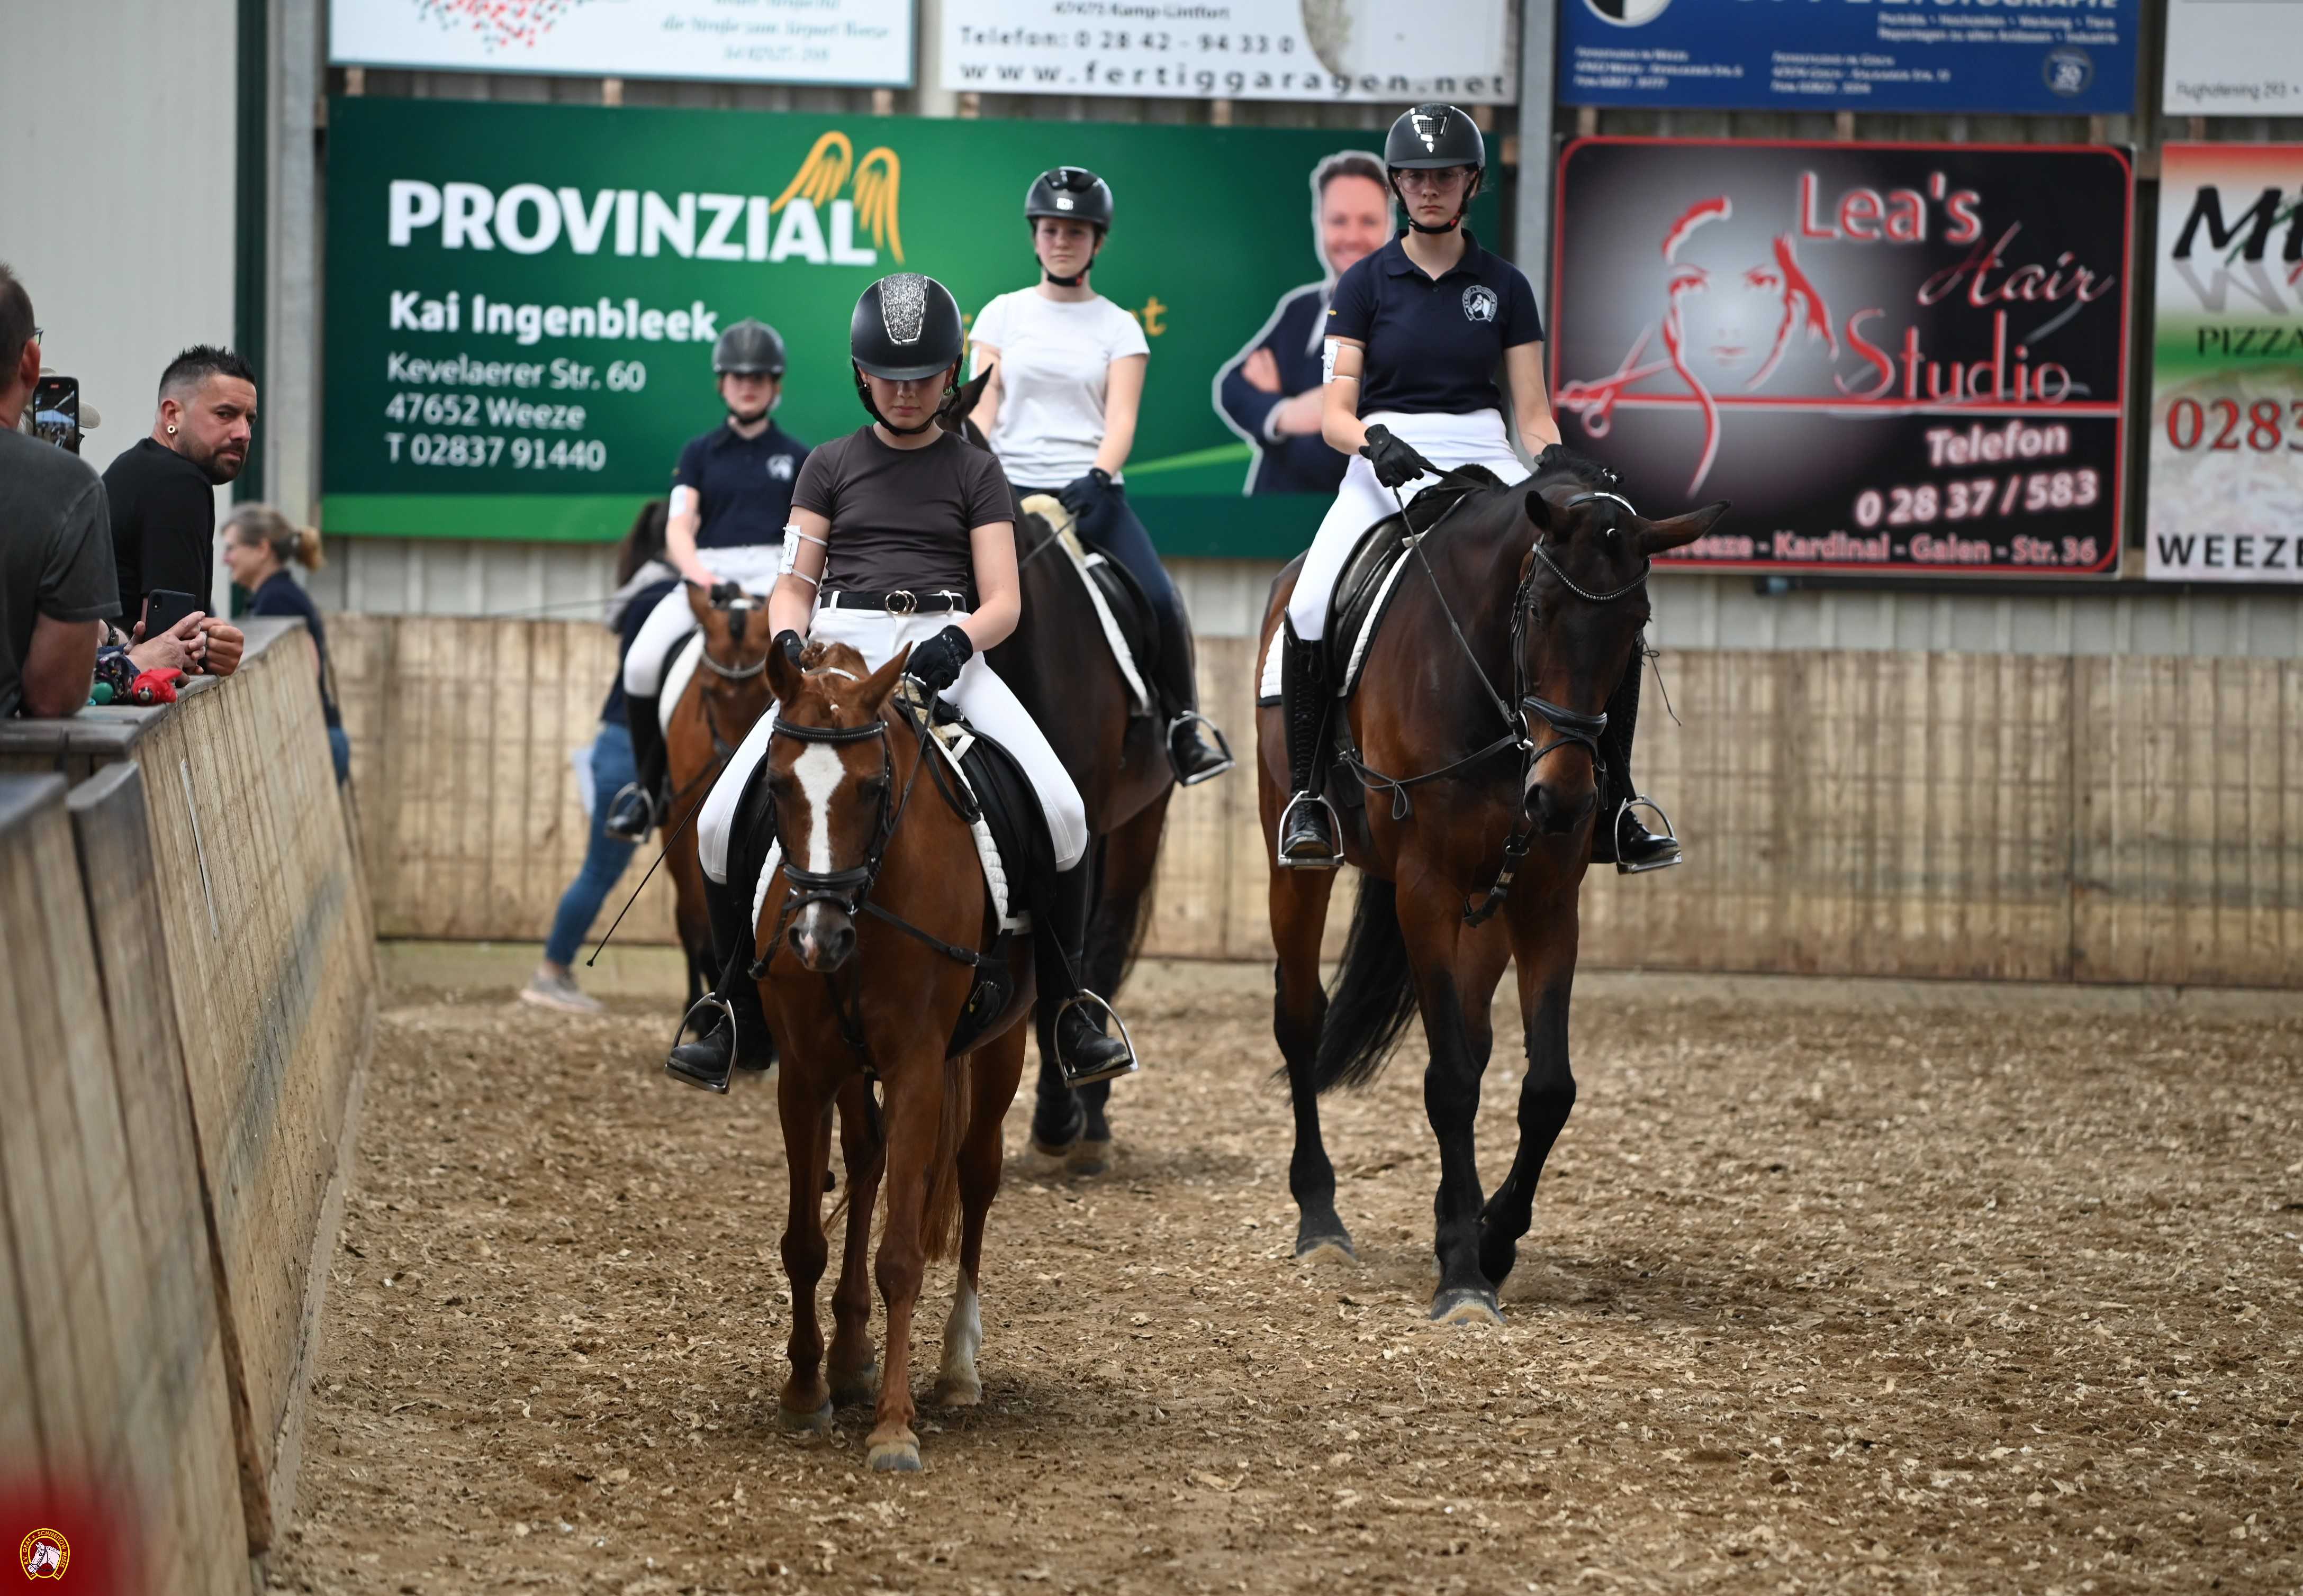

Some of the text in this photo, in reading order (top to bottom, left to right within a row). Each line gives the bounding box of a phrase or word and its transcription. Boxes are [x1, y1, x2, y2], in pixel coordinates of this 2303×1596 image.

[960, 26, 1068, 47] Telefon:
[1100, 31, 1131, 50] 28
[1140, 32, 1171, 51] 42
[960, 60, 1505, 95] www.fertiggaragen.net
[388, 179, 877, 266] PROVINZIAL
[1801, 170, 1982, 243] Lea's
[1917, 221, 2115, 307] Hair
[389, 289, 719, 346] Kai Ingenbleek
[386, 351, 646, 393] Kevelaerer Str. 60
[1834, 308, 2071, 403] Studio
[384, 392, 587, 431] 47652 Weeze
[383, 432, 607, 472] T 02837 91440
[1925, 420, 2071, 467] Telefon
[1855, 490, 1883, 528] 0
[1887, 485, 1939, 525] 28
[1945, 479, 1996, 520] 37
[2024, 467, 2100, 511] 583
[1666, 534, 1754, 559] eeze
[1773, 530, 1891, 560] Kardinal
[1909, 532, 1992, 563] Galen
[2012, 534, 2058, 565] Str.
[2061, 536, 2098, 566] 36
